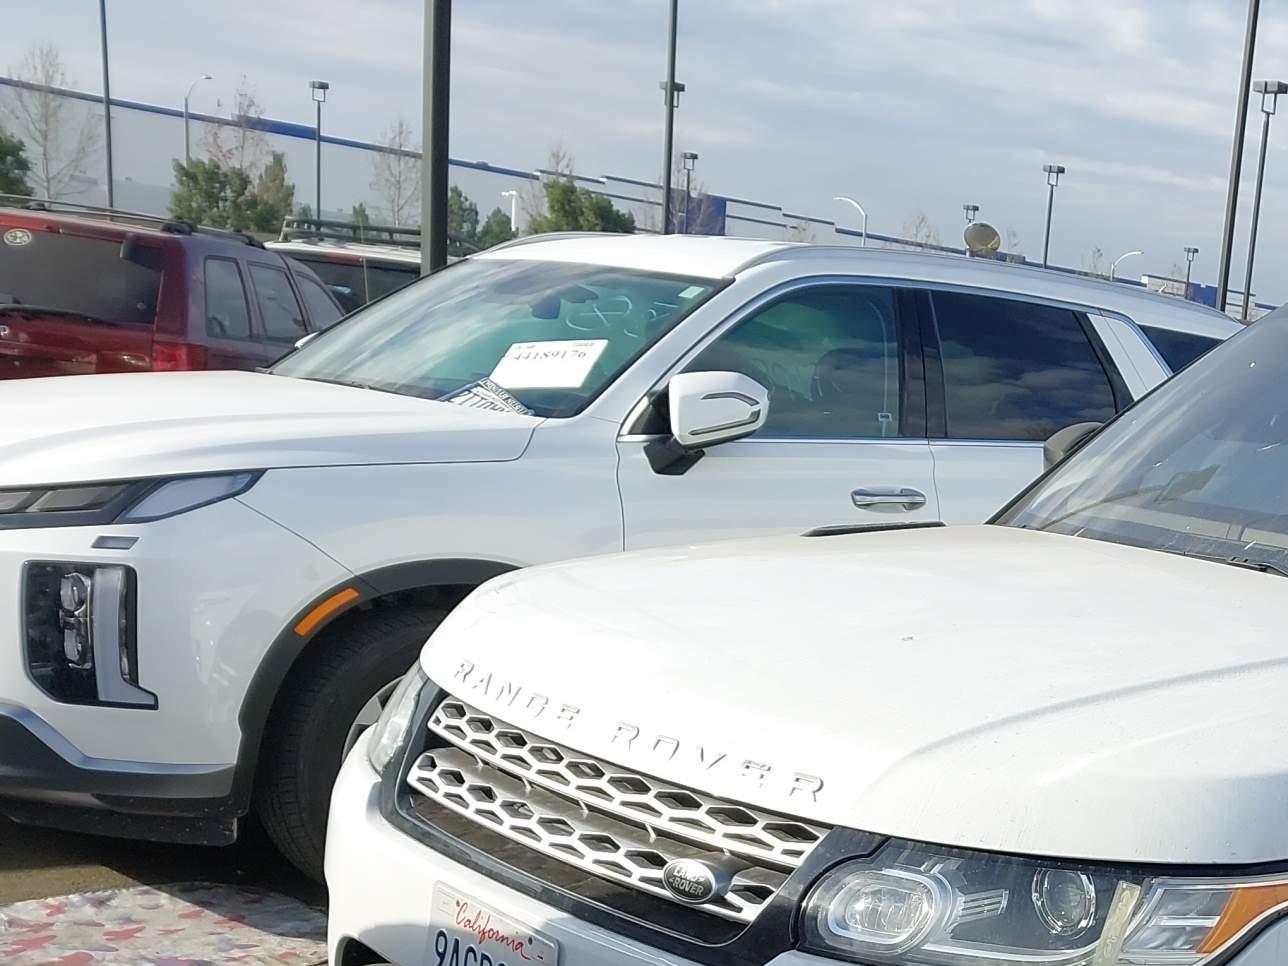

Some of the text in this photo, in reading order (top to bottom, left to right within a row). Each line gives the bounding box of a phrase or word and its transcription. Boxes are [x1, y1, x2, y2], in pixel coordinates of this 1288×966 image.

[454, 659, 824, 803] RANGE ROVER
[673, 877, 704, 896] ROVER
[455, 902, 531, 961] California
